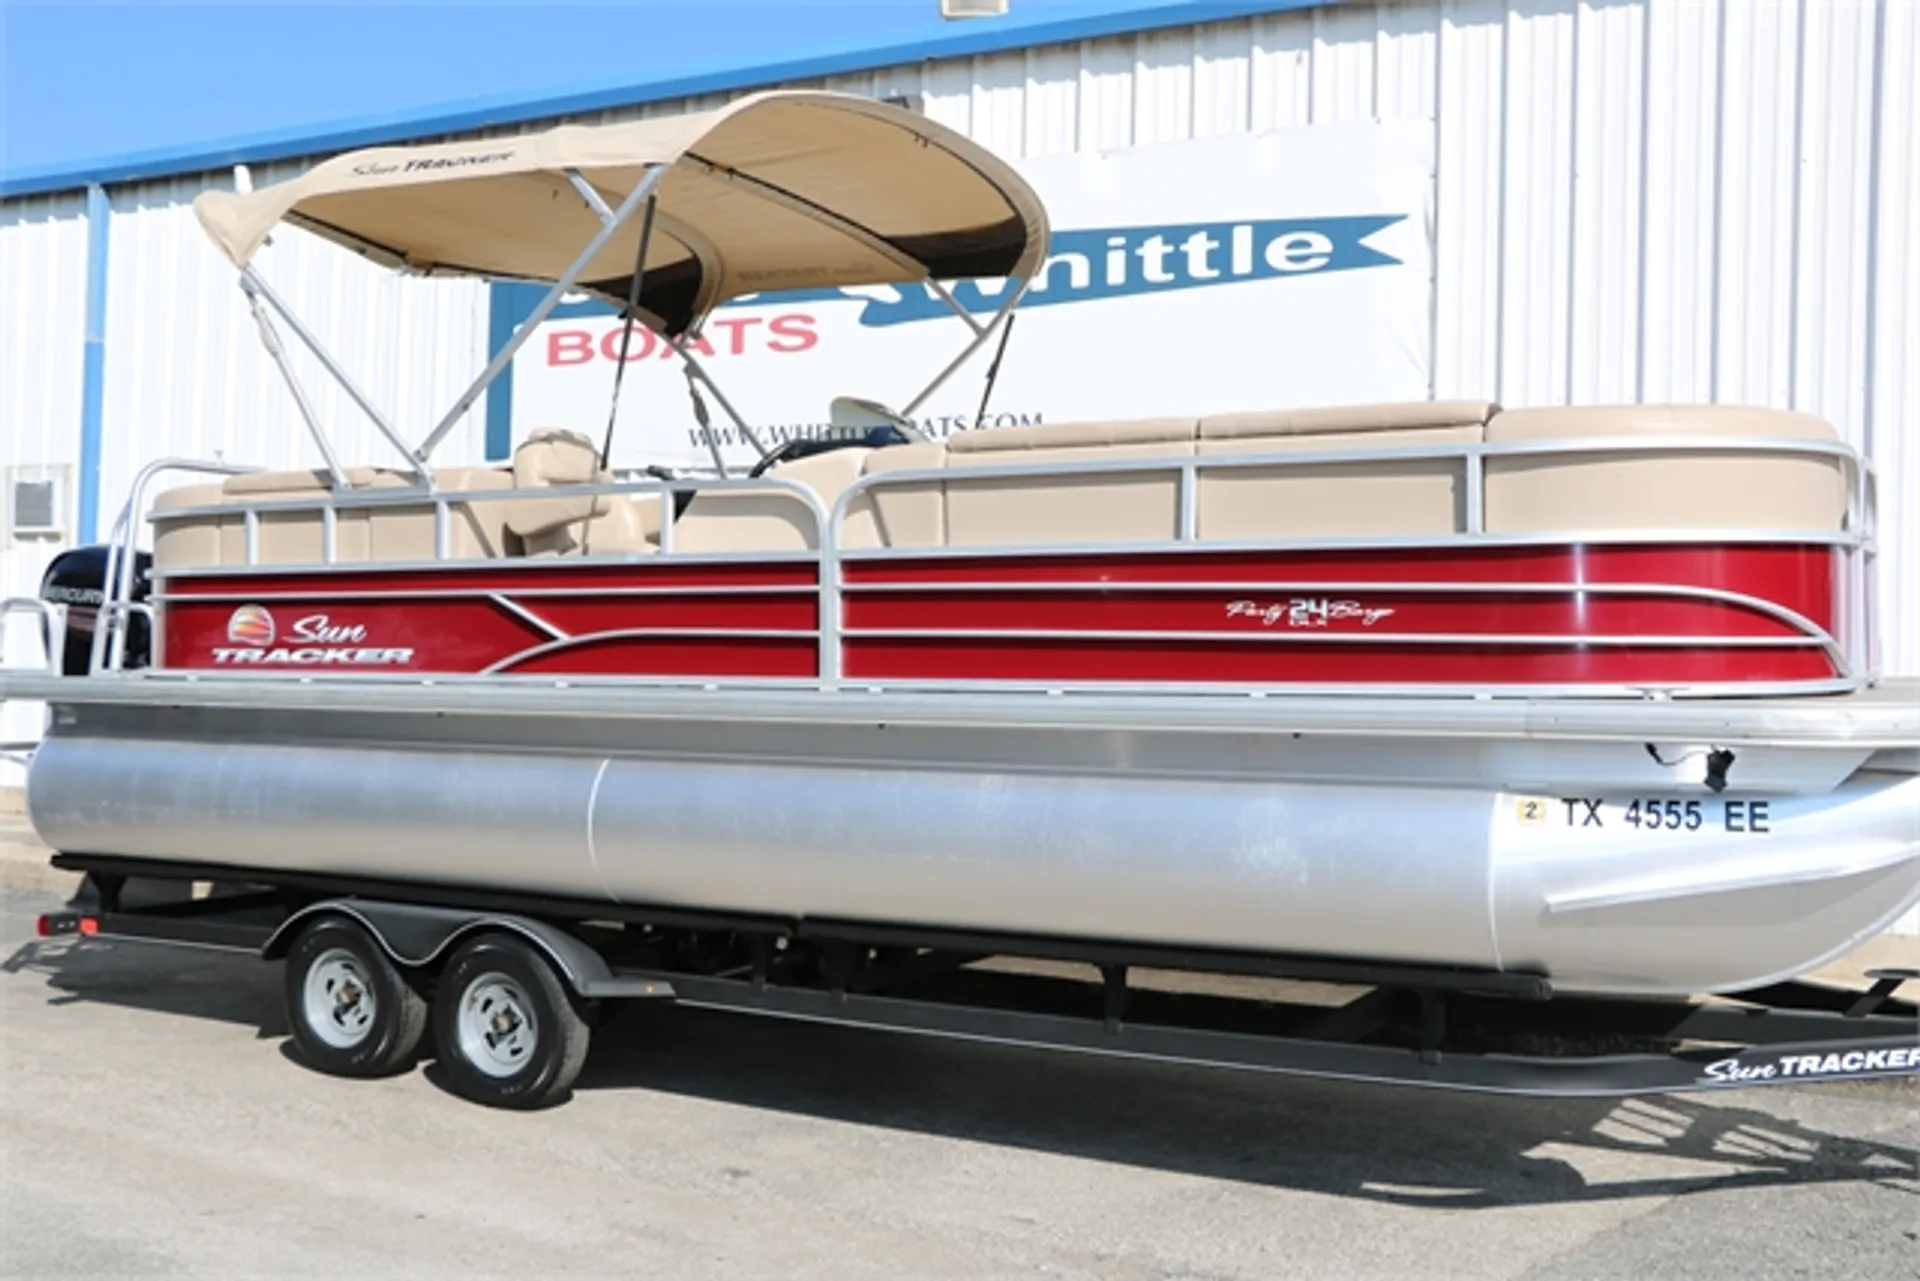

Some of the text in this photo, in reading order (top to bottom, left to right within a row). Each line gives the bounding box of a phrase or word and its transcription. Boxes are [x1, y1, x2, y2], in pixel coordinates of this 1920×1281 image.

[924, 225, 1334, 299] hittle
[547, 314, 819, 366] BOATS
[1289, 598, 1328, 620] 24
[282, 614, 367, 644] Sun
[212, 647, 415, 664] TRACKER
[1524, 802, 1538, 819] 2
[1561, 798, 1770, 832] TX 4555 EE
[1703, 1058, 1777, 1081] Sun
